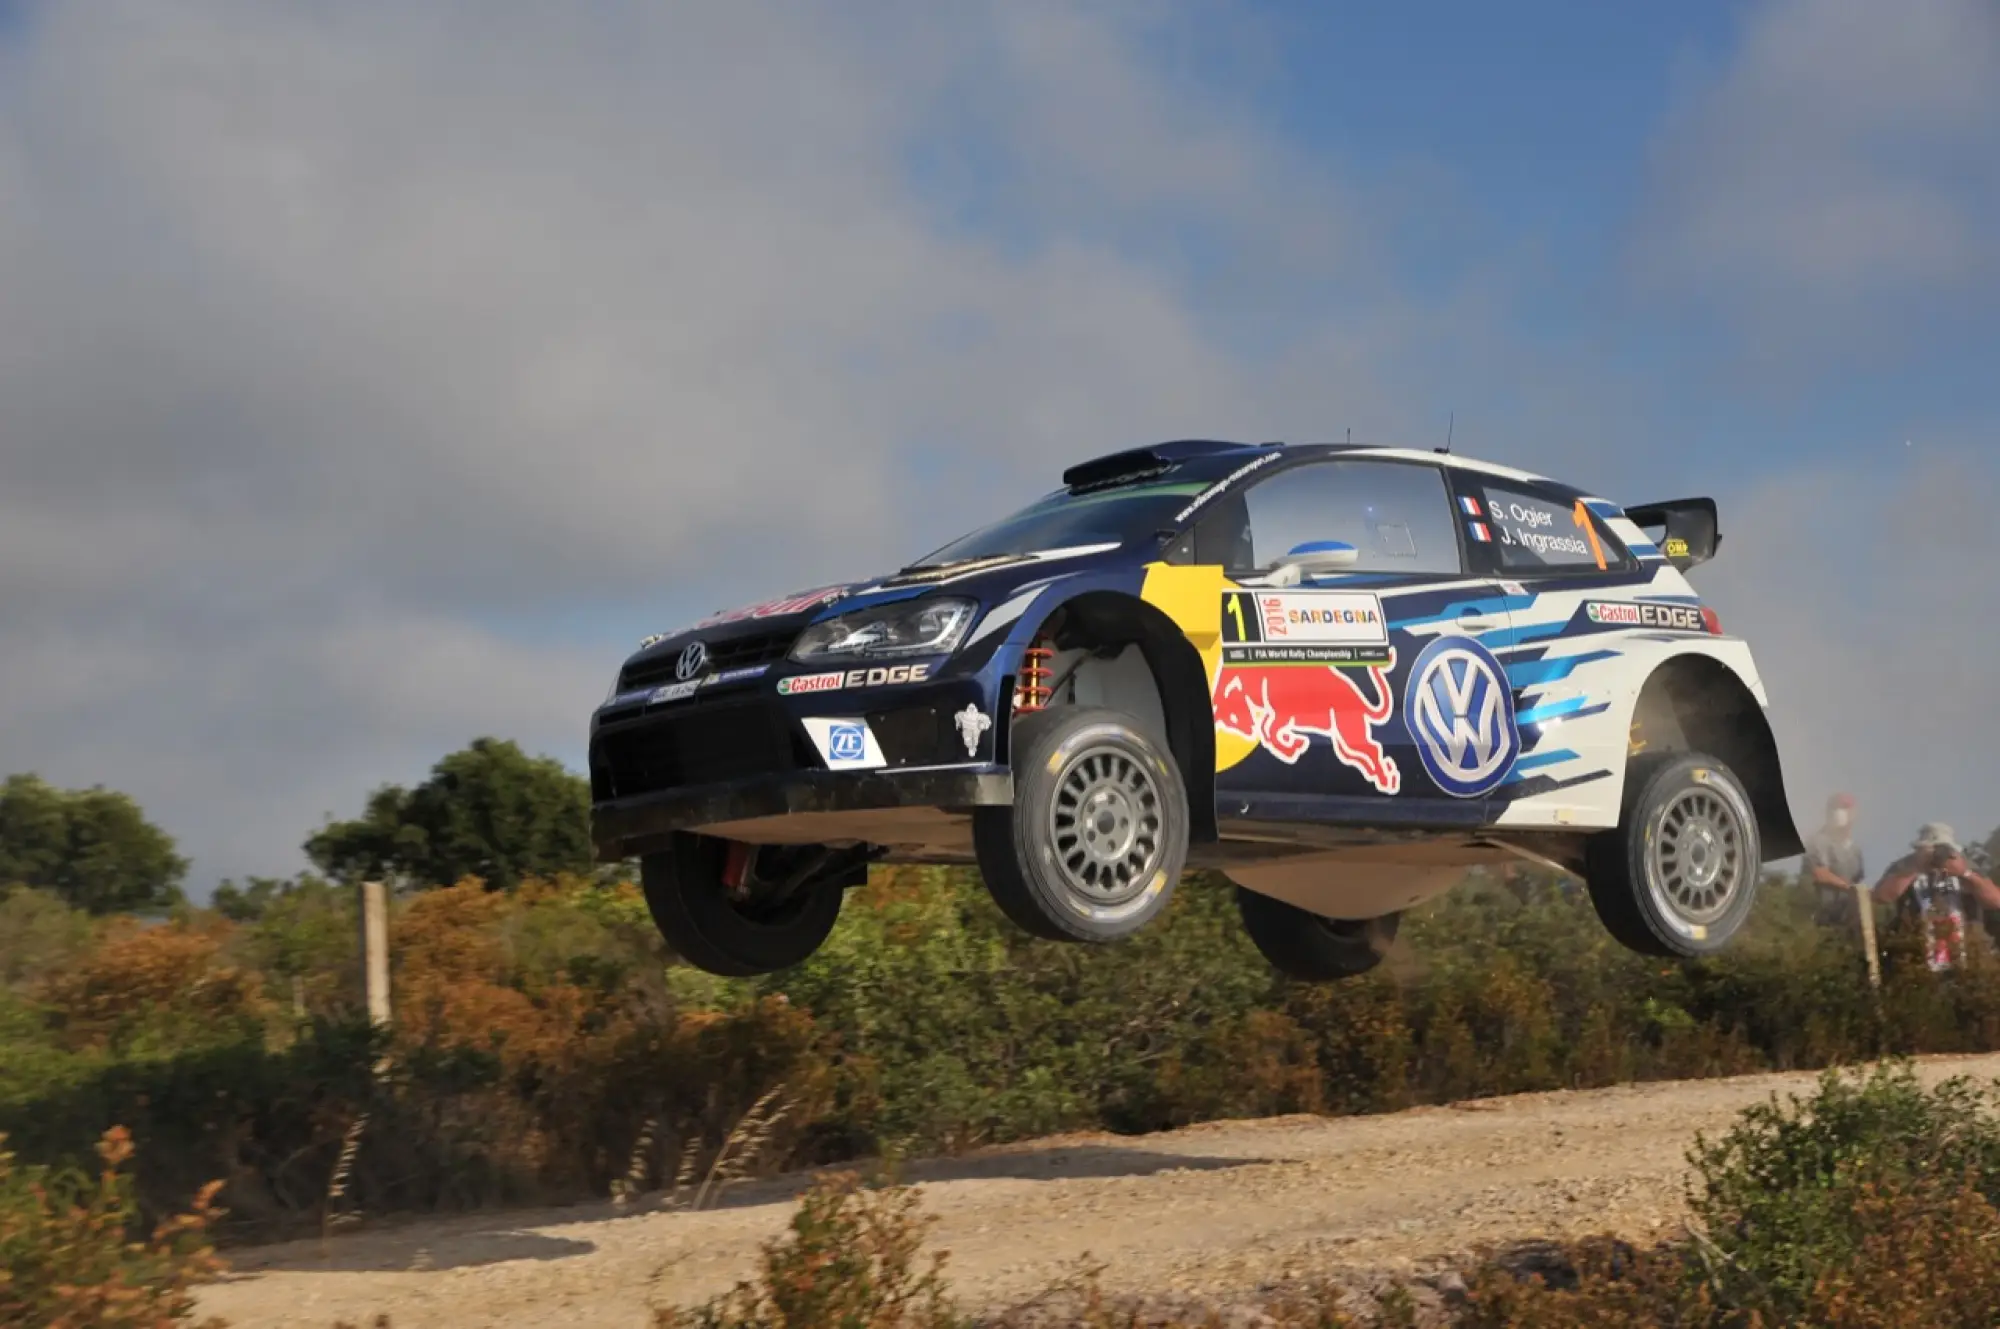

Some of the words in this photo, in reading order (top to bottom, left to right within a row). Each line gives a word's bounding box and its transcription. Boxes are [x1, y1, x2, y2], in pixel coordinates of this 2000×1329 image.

[1488, 500, 1508, 520] S.
[1510, 503, 1552, 529] Ogier
[1501, 525, 1516, 546] J.
[1516, 527, 1588, 555] Ingrassia
[1571, 501, 1607, 571] 1
[1227, 593, 1247, 642] 1
[1263, 598, 1288, 635] 2016
[1288, 609, 1378, 624] SARDEGNA
[1600, 604, 1638, 623] Castrol
[1641, 605, 1701, 629] EDGE
[1268, 649, 1287, 659] World
[1288, 649, 1305, 660] Rally
[1307, 649, 1351, 660] Championship
[791, 673, 841, 692] Castrol
[845, 664, 931, 688] EDGE
[836, 733, 858, 752] ZF
